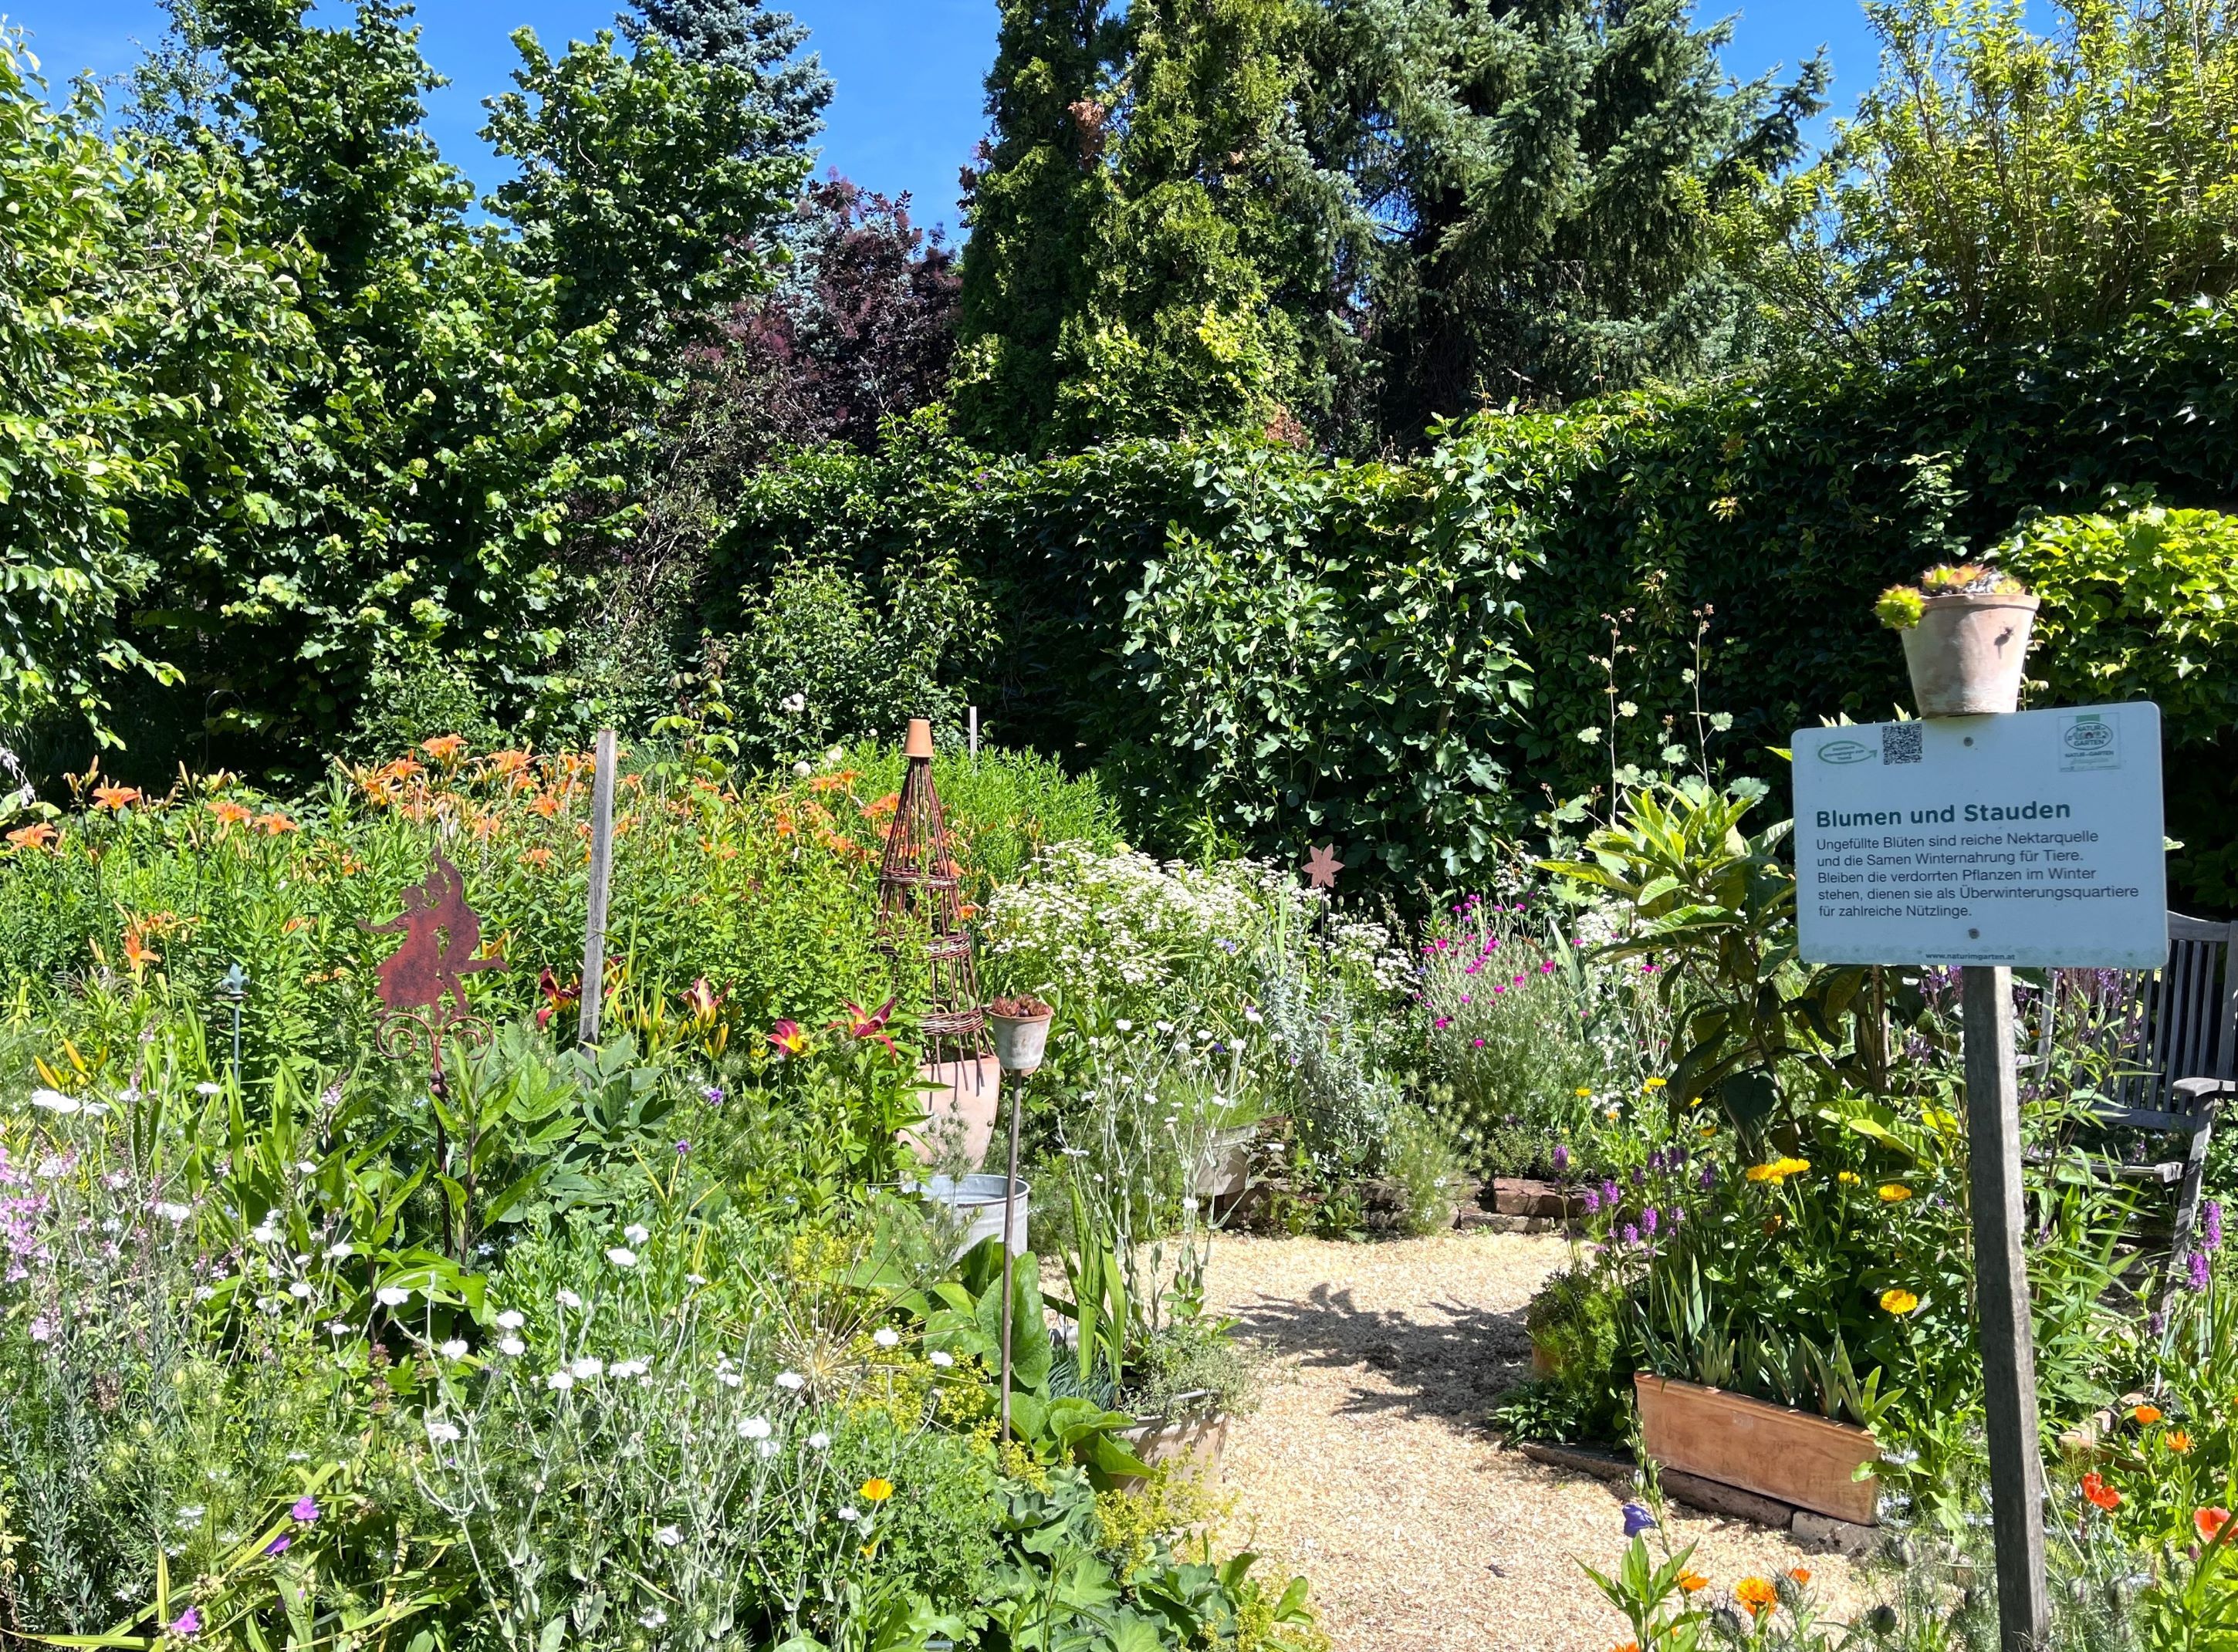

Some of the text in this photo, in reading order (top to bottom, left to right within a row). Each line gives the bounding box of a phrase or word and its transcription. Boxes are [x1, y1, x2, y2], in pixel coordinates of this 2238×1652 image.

[1817, 801, 2071, 827] Blumen und Stauden
[1817, 830, 2099, 853] Ungefüllte Blüten sind reiche Nektarquelle
[1817, 850, 2084, 867] und die Samen Winternahrung für Tiere.
[1818, 867, 2097, 883] Bleiben die verdorrten Pflanzen im Winter
[1818, 884, 2139, 901] stehen, dienen sie als Überwinterungsquartiere
[1819, 904, 1973, 919] für zahlreiche Nützlinge.
